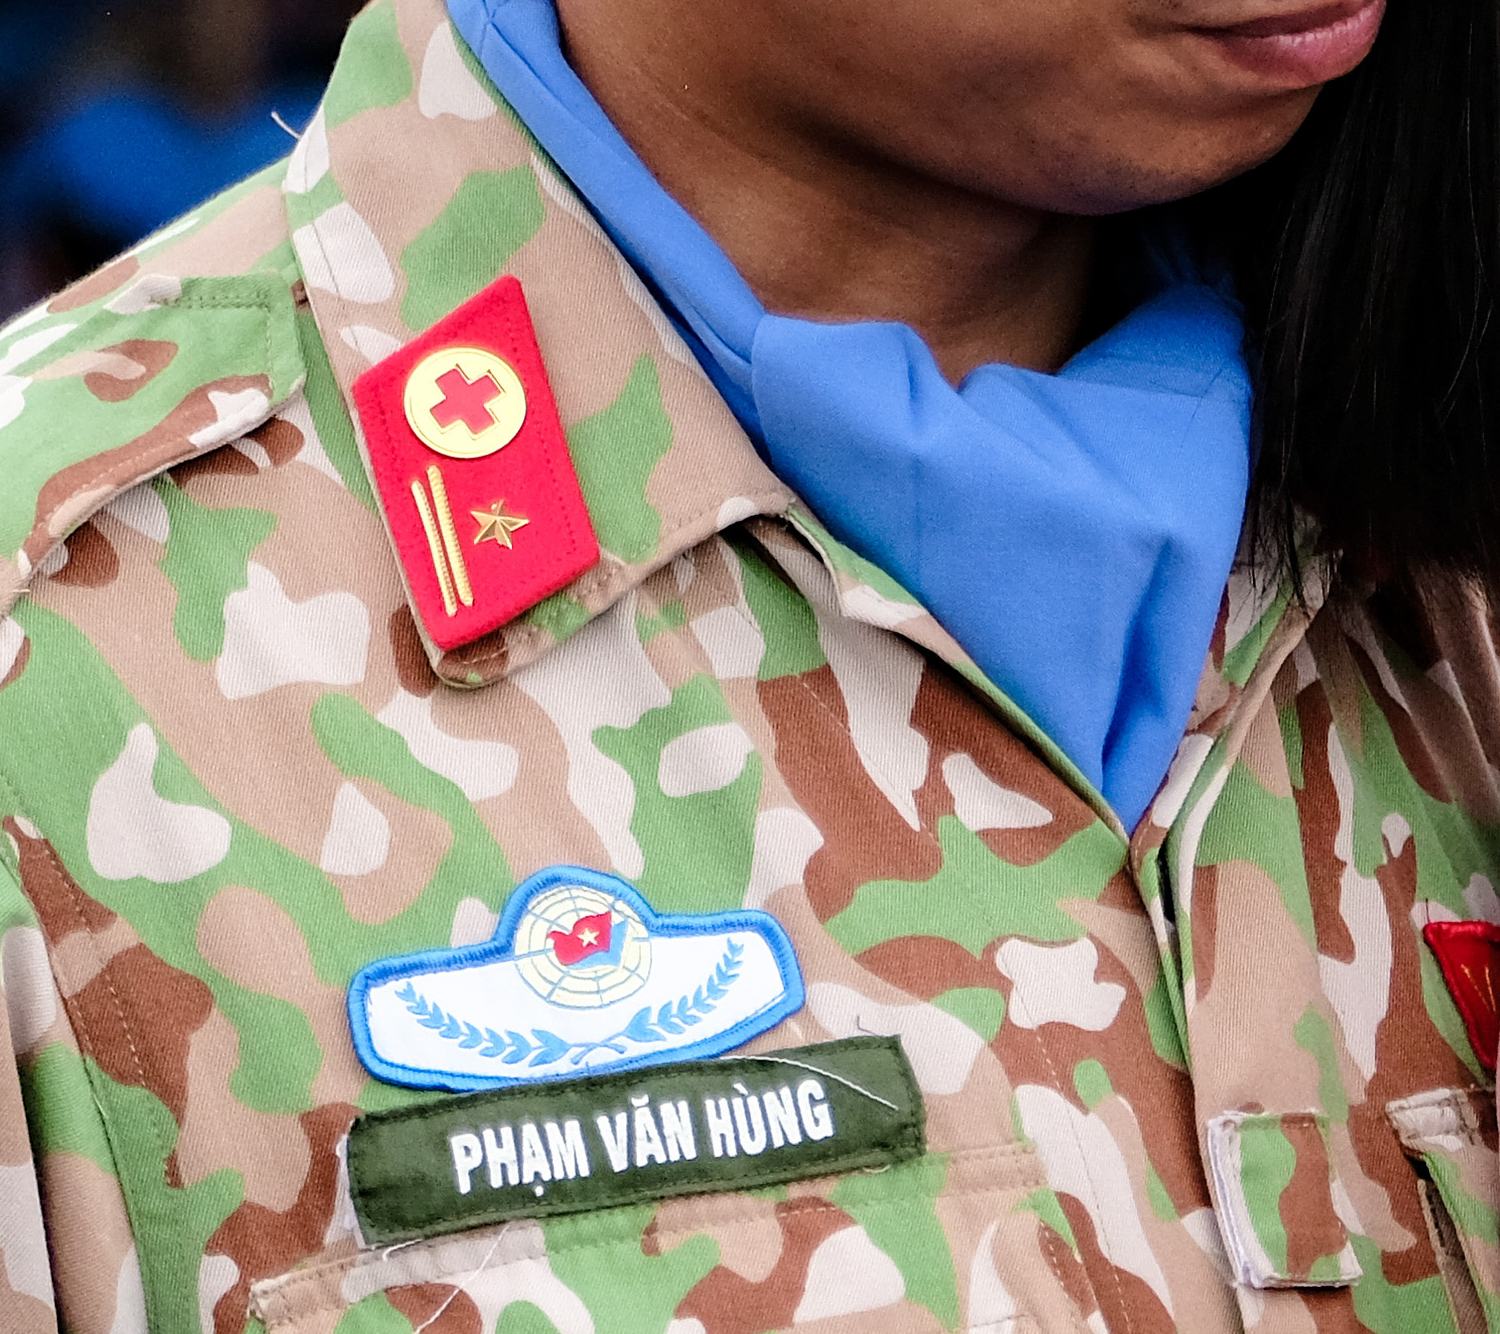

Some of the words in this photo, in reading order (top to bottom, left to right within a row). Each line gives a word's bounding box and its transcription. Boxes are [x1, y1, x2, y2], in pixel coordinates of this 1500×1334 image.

[450, 1119, 591, 1198] PHẠM
[596, 1093, 698, 1174] VĂN
[704, 1078, 835, 1158] HÙNG
